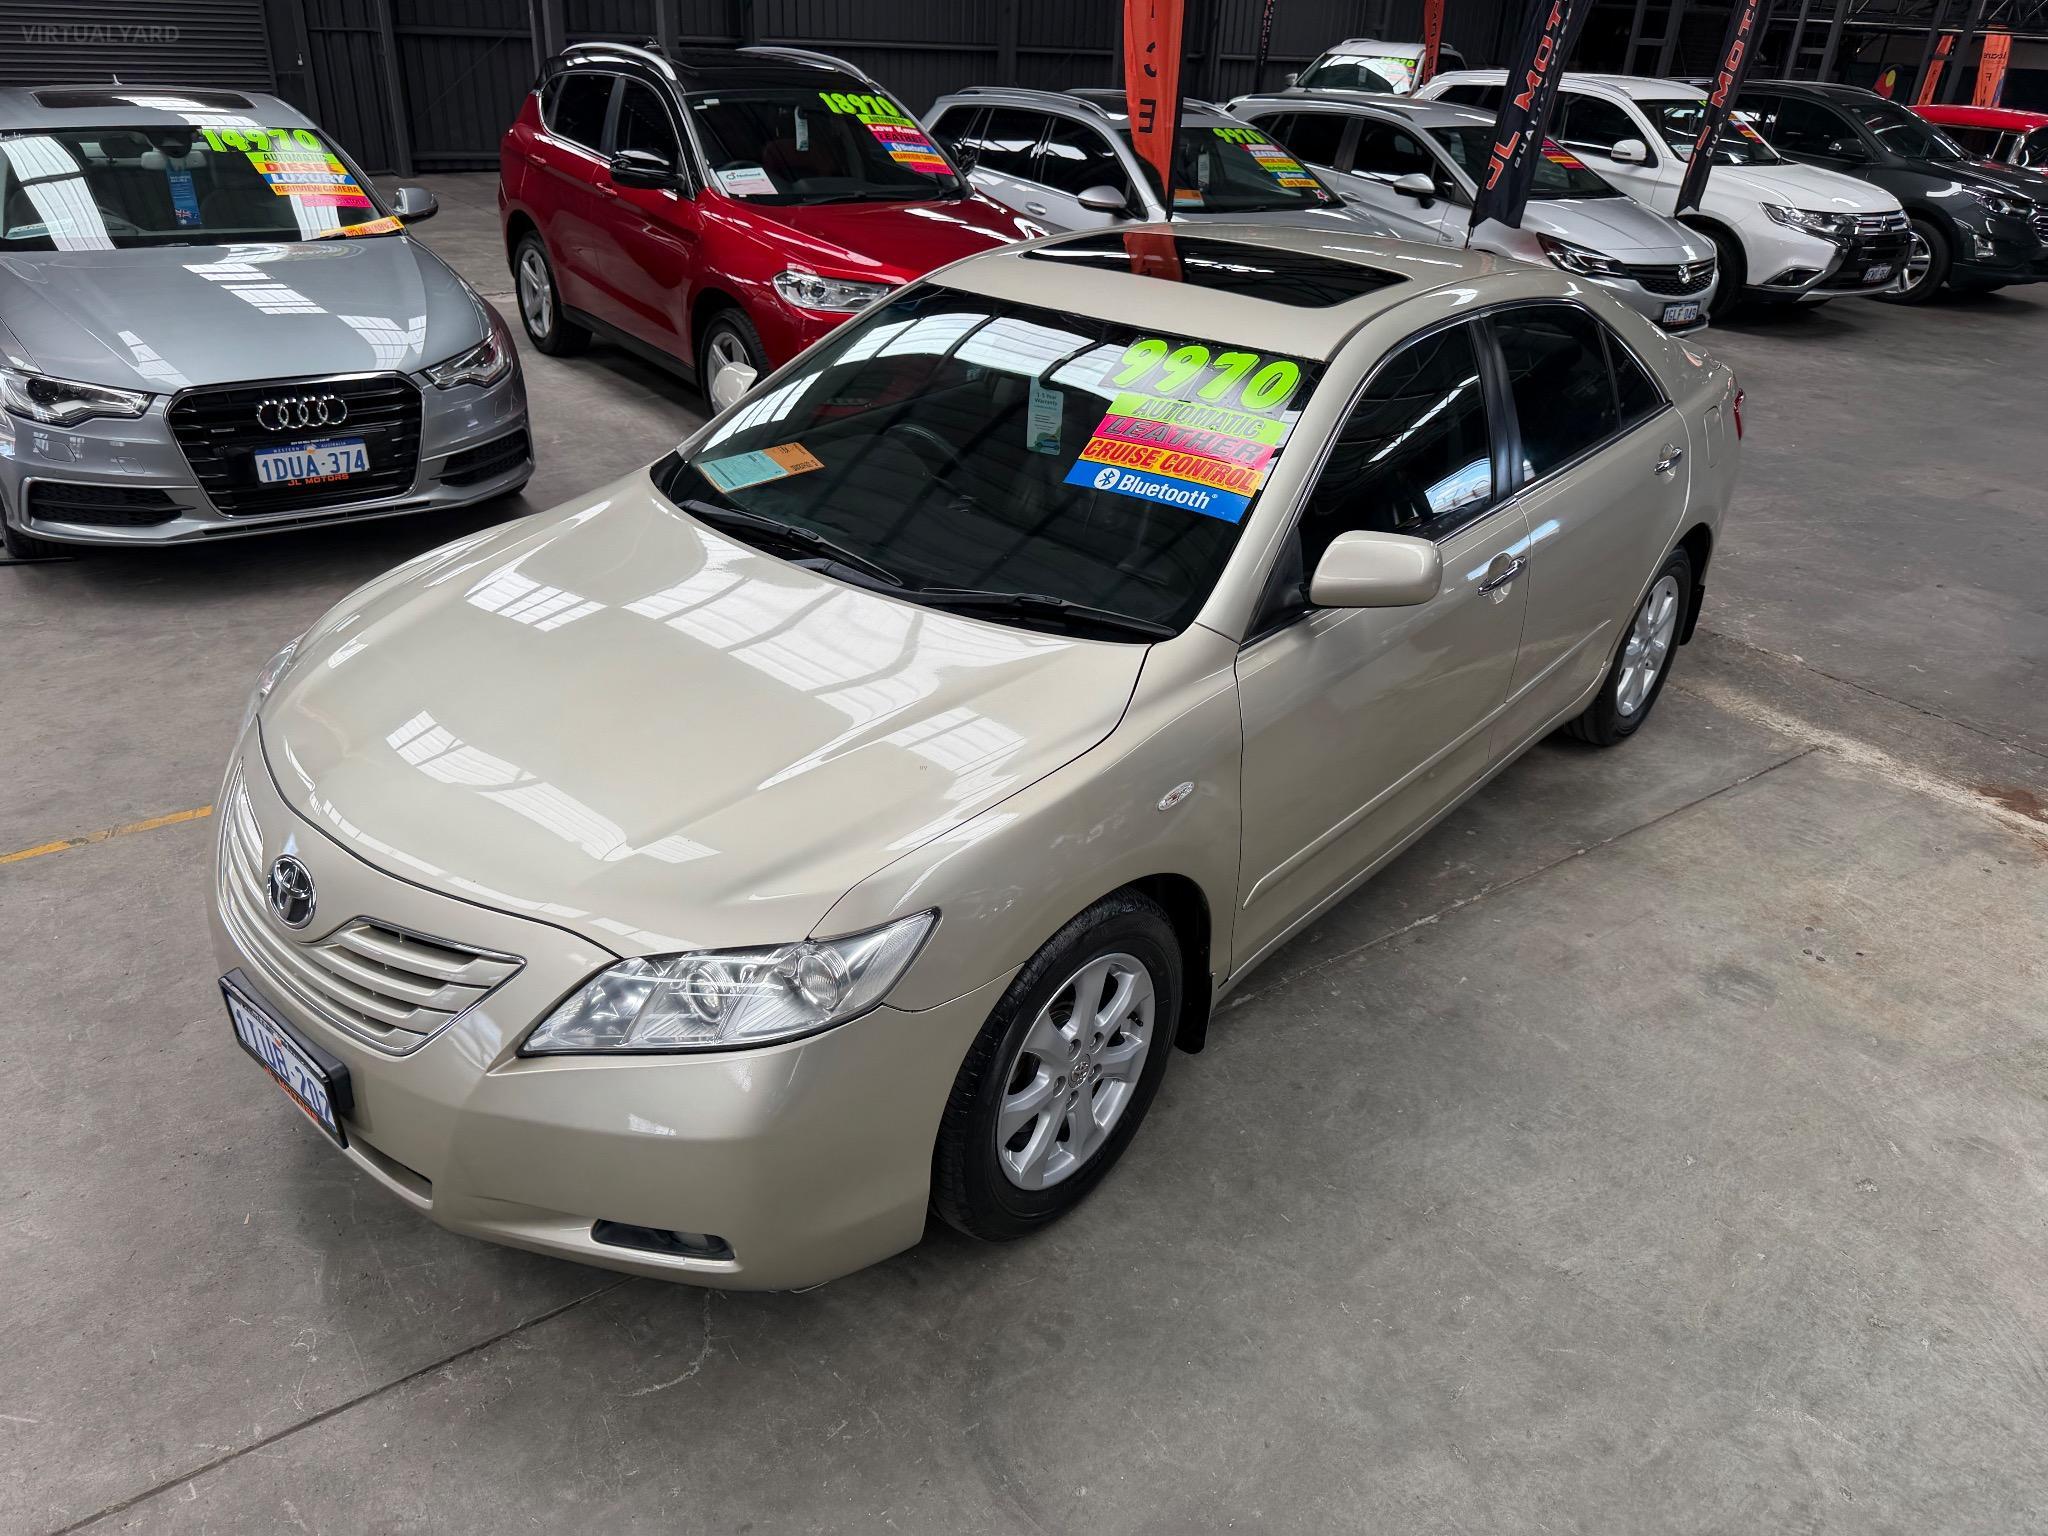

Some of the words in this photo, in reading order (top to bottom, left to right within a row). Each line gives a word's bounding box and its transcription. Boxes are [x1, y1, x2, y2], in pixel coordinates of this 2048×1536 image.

[819, 92, 900, 118] 18970
[202, 128, 323, 152] 14970
[1213, 127, 1268, 144] 9970
[263, 153, 328, 162] AUTOMATIC
[265, 163, 340, 172] DIESEL
[1486, 131, 1521, 191] JL
[271, 173, 347, 184] LUXURY
[275, 185, 321, 193] REARVIEW
[322, 185, 360, 193] CAMERA
[1111, 339, 1302, 410] 9970
[1133, 398, 1266, 438] AUTOMATIC
[1104, 417, 1264, 463] LEATHER
[1084, 440, 1159, 470] CRUISE
[1159, 453, 1254, 493] CONTROL
[287, 479, 303, 487] JL
[305, 473, 350, 485] MOTORS
[1117, 474, 1213, 510] Bluetooth
